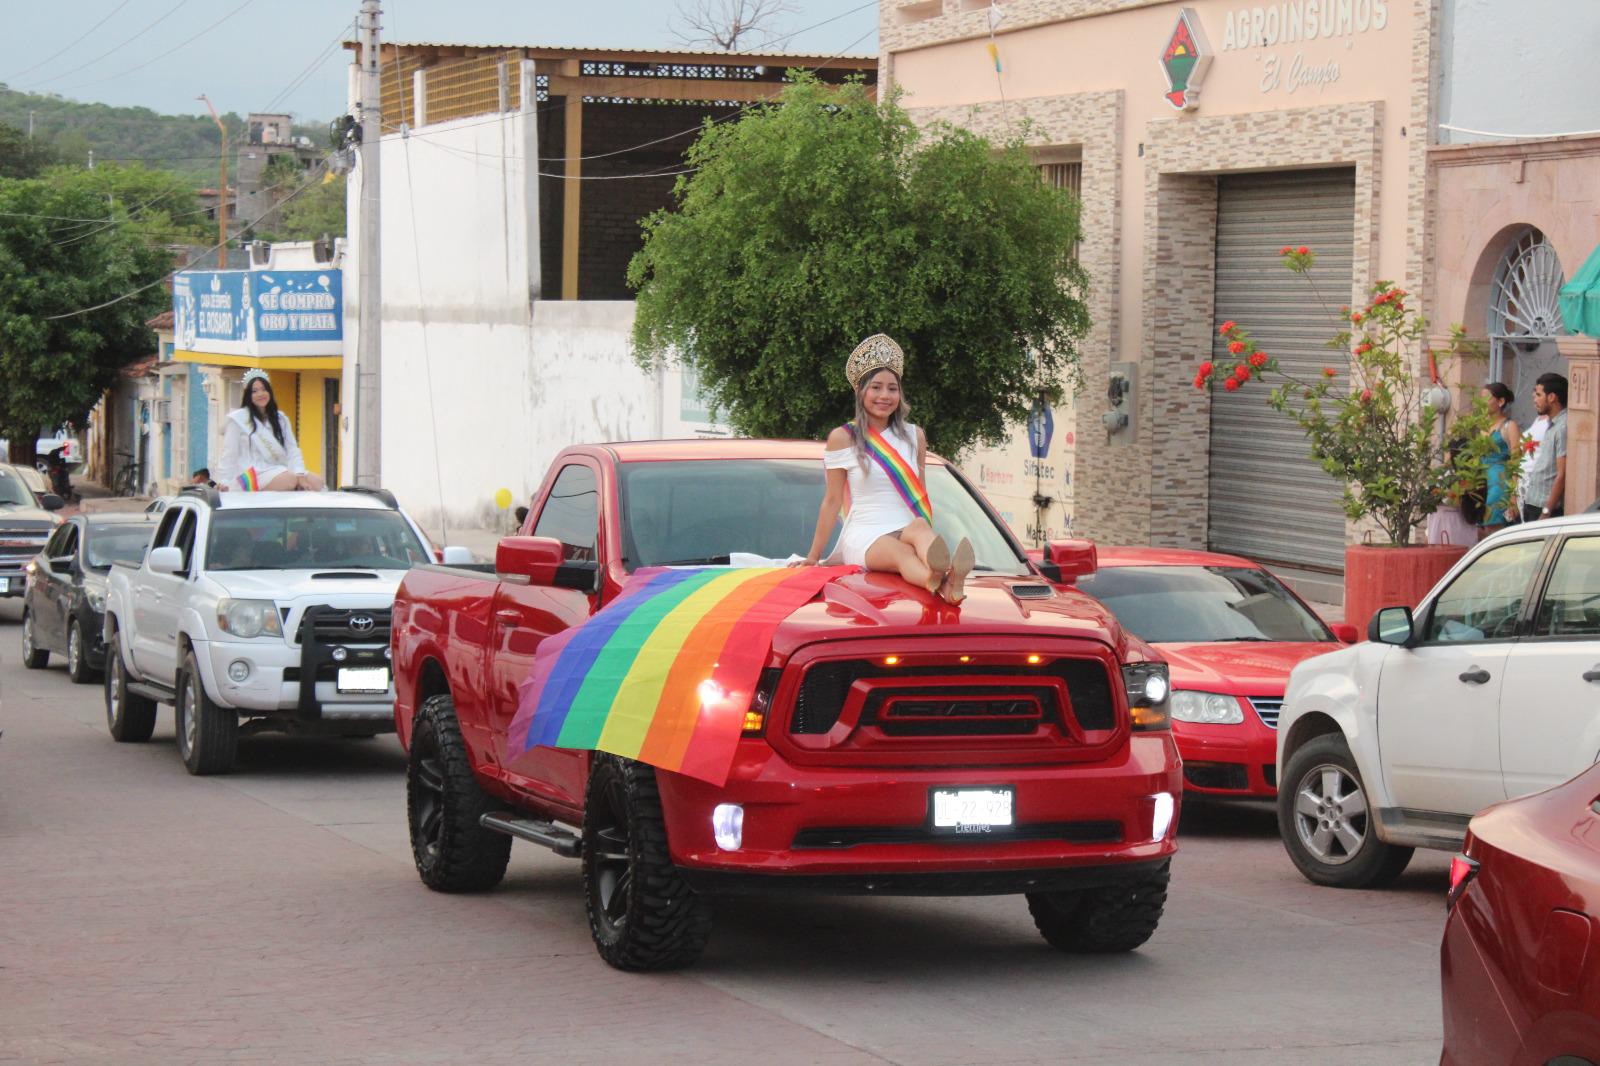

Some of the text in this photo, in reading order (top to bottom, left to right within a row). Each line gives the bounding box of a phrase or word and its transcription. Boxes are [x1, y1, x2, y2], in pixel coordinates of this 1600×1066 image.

[1223, 0, 1388, 51] AGROINSUMOS
[1260, 52, 1341, 94] El Campo
[261, 293, 334, 310] SE COMPRA
[199, 312, 232, 335] EL ROSARIO
[261, 314, 336, 330] ORO Y PLATA
